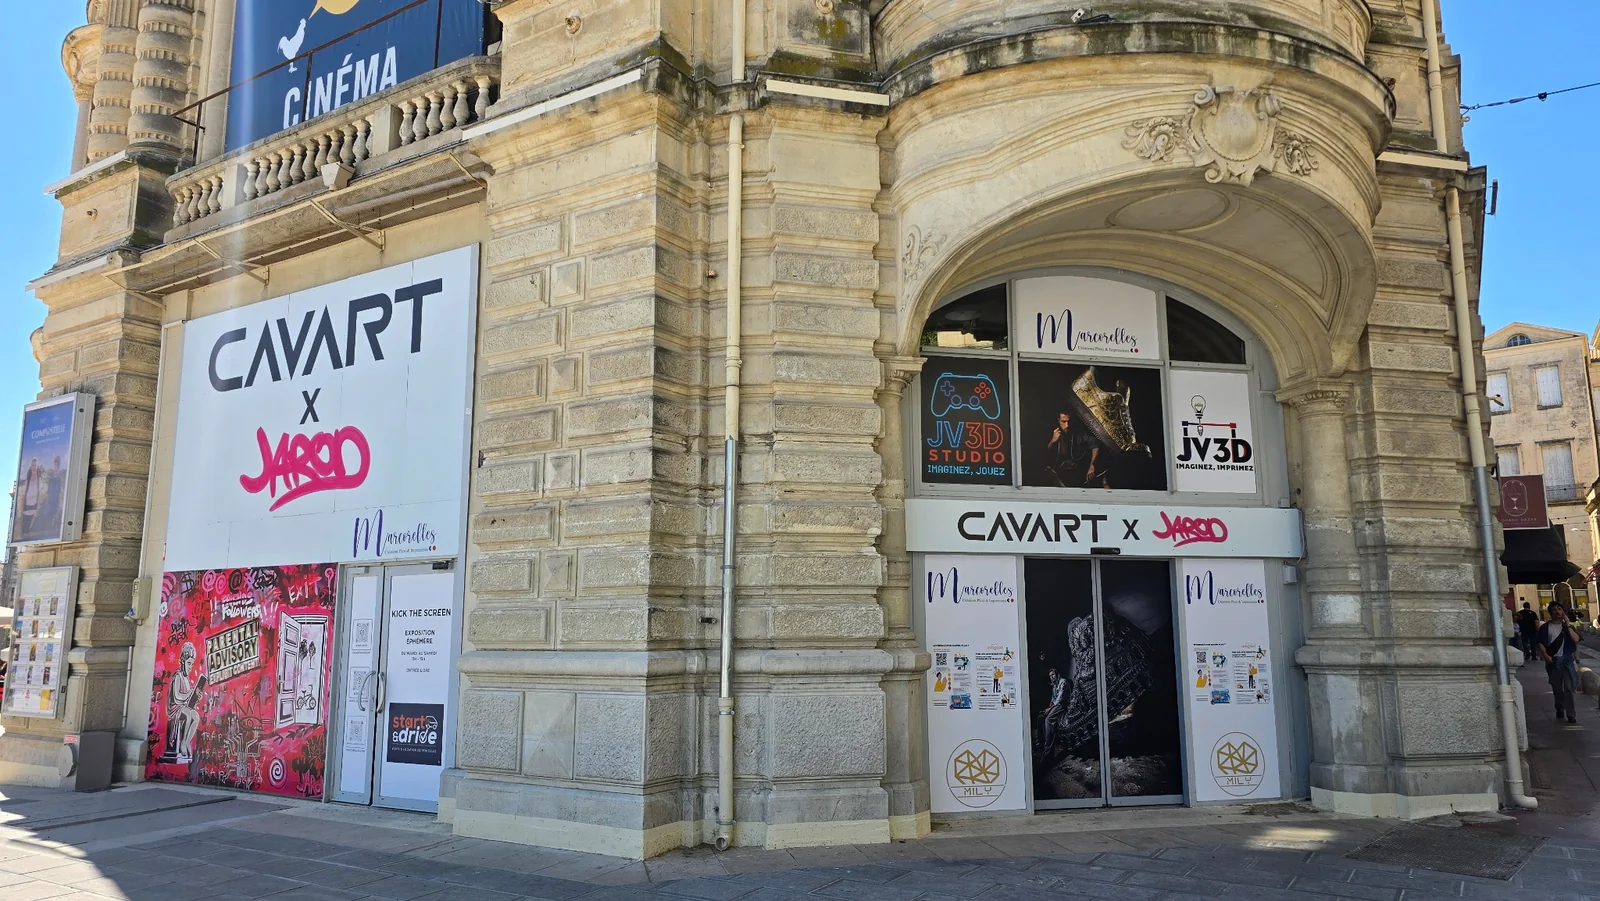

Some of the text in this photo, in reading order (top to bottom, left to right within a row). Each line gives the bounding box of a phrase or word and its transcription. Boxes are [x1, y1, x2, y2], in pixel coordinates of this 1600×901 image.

[282, 45, 398, 130] CINÉMA
[208, 278, 443, 392] CAVART
[1036, 308, 1140, 352] Marcorelles
[926, 420, 1004, 450] JV3D
[1176, 436, 1253, 464] JV3D
[239, 425, 371, 512] JAROD
[927, 464, 1006, 476] IMAGINEZ, JOUEZ
[928, 449, 1005, 464] STUDIO
[1175, 463, 1254, 472] IMAGINEZ, IMPRIMEZ
[352, 508, 438, 558] Marcorelles
[957, 511, 1108, 543] CAVART
[1152, 510, 1229, 548] JAROD
[927, 566, 1014, 605] Marcorelles
[1186, 570, 1264, 605] Marcorelles
[391, 608, 451, 618] KICK THE SCREEN
[206, 621, 259, 654] PARENTAL
[208, 638, 258, 673] ADVISORY
[392, 714, 426, 730] start
